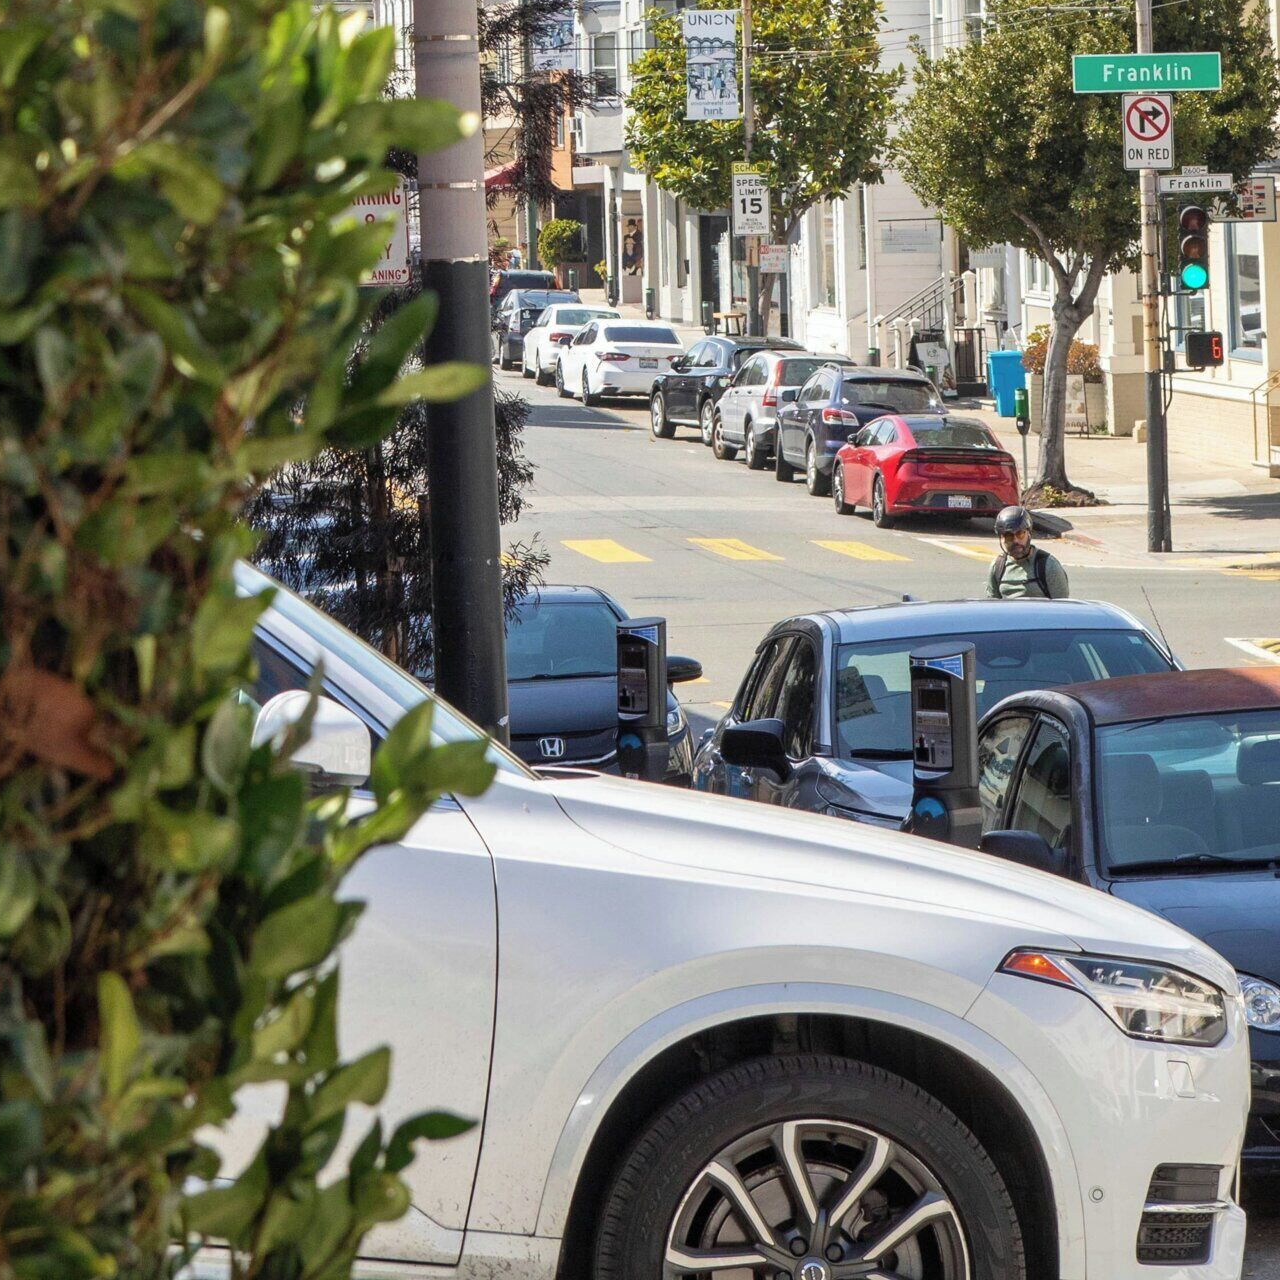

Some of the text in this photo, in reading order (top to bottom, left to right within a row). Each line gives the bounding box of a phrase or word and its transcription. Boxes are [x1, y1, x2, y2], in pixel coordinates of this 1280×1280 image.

[688, 14, 735, 26] UNION
[1103, 63, 1192, 83] Franklin
[1128, 148, 1170, 160] ON RED
[736, 179, 761, 187] SPEE
[1169, 179, 1222, 189] Franklin
[351, 184, 401, 206] KING
[739, 188, 763, 196] LIMIT
[740, 198, 762, 214] 15
[371, 270, 401, 280] ANING
